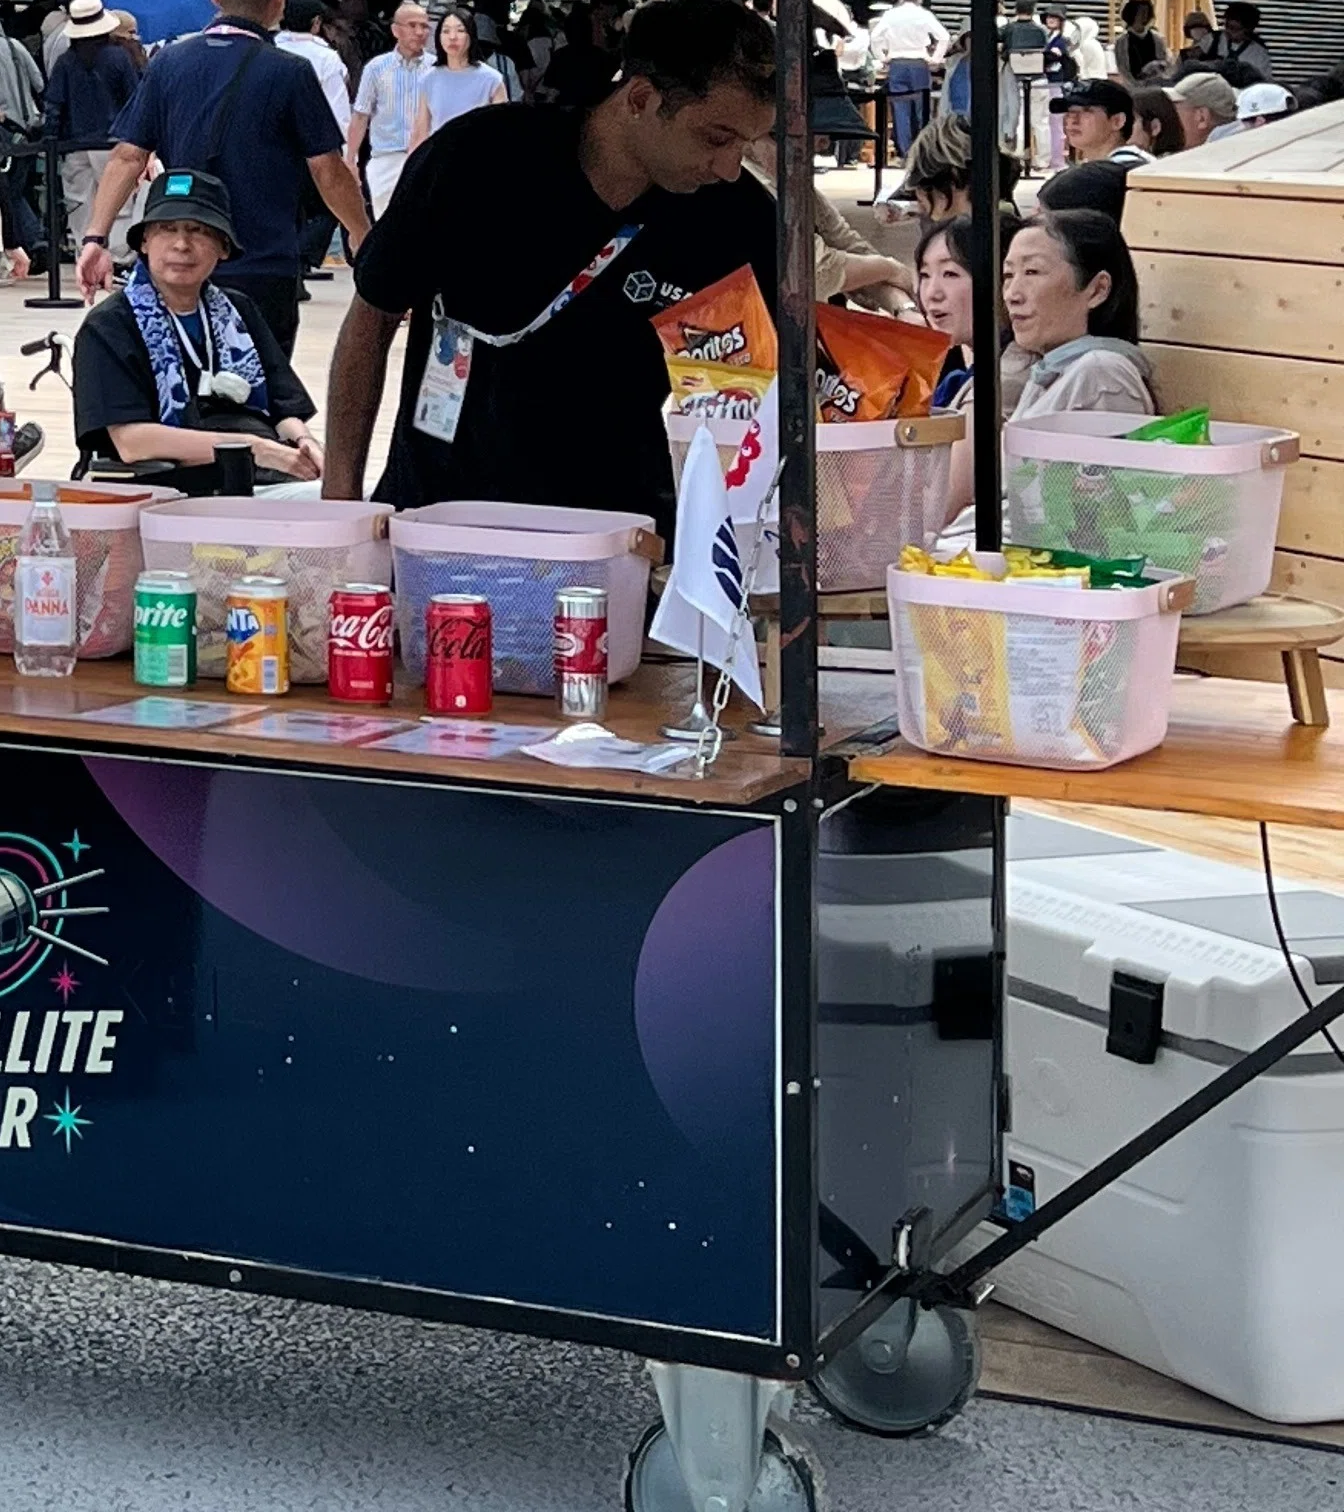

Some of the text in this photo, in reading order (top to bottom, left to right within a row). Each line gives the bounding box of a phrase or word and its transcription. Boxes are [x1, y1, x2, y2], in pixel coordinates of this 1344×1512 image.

[24, 596, 69, 616] PANNA
[134, 601, 188, 628] prite
[227, 607, 260, 632] NTA
